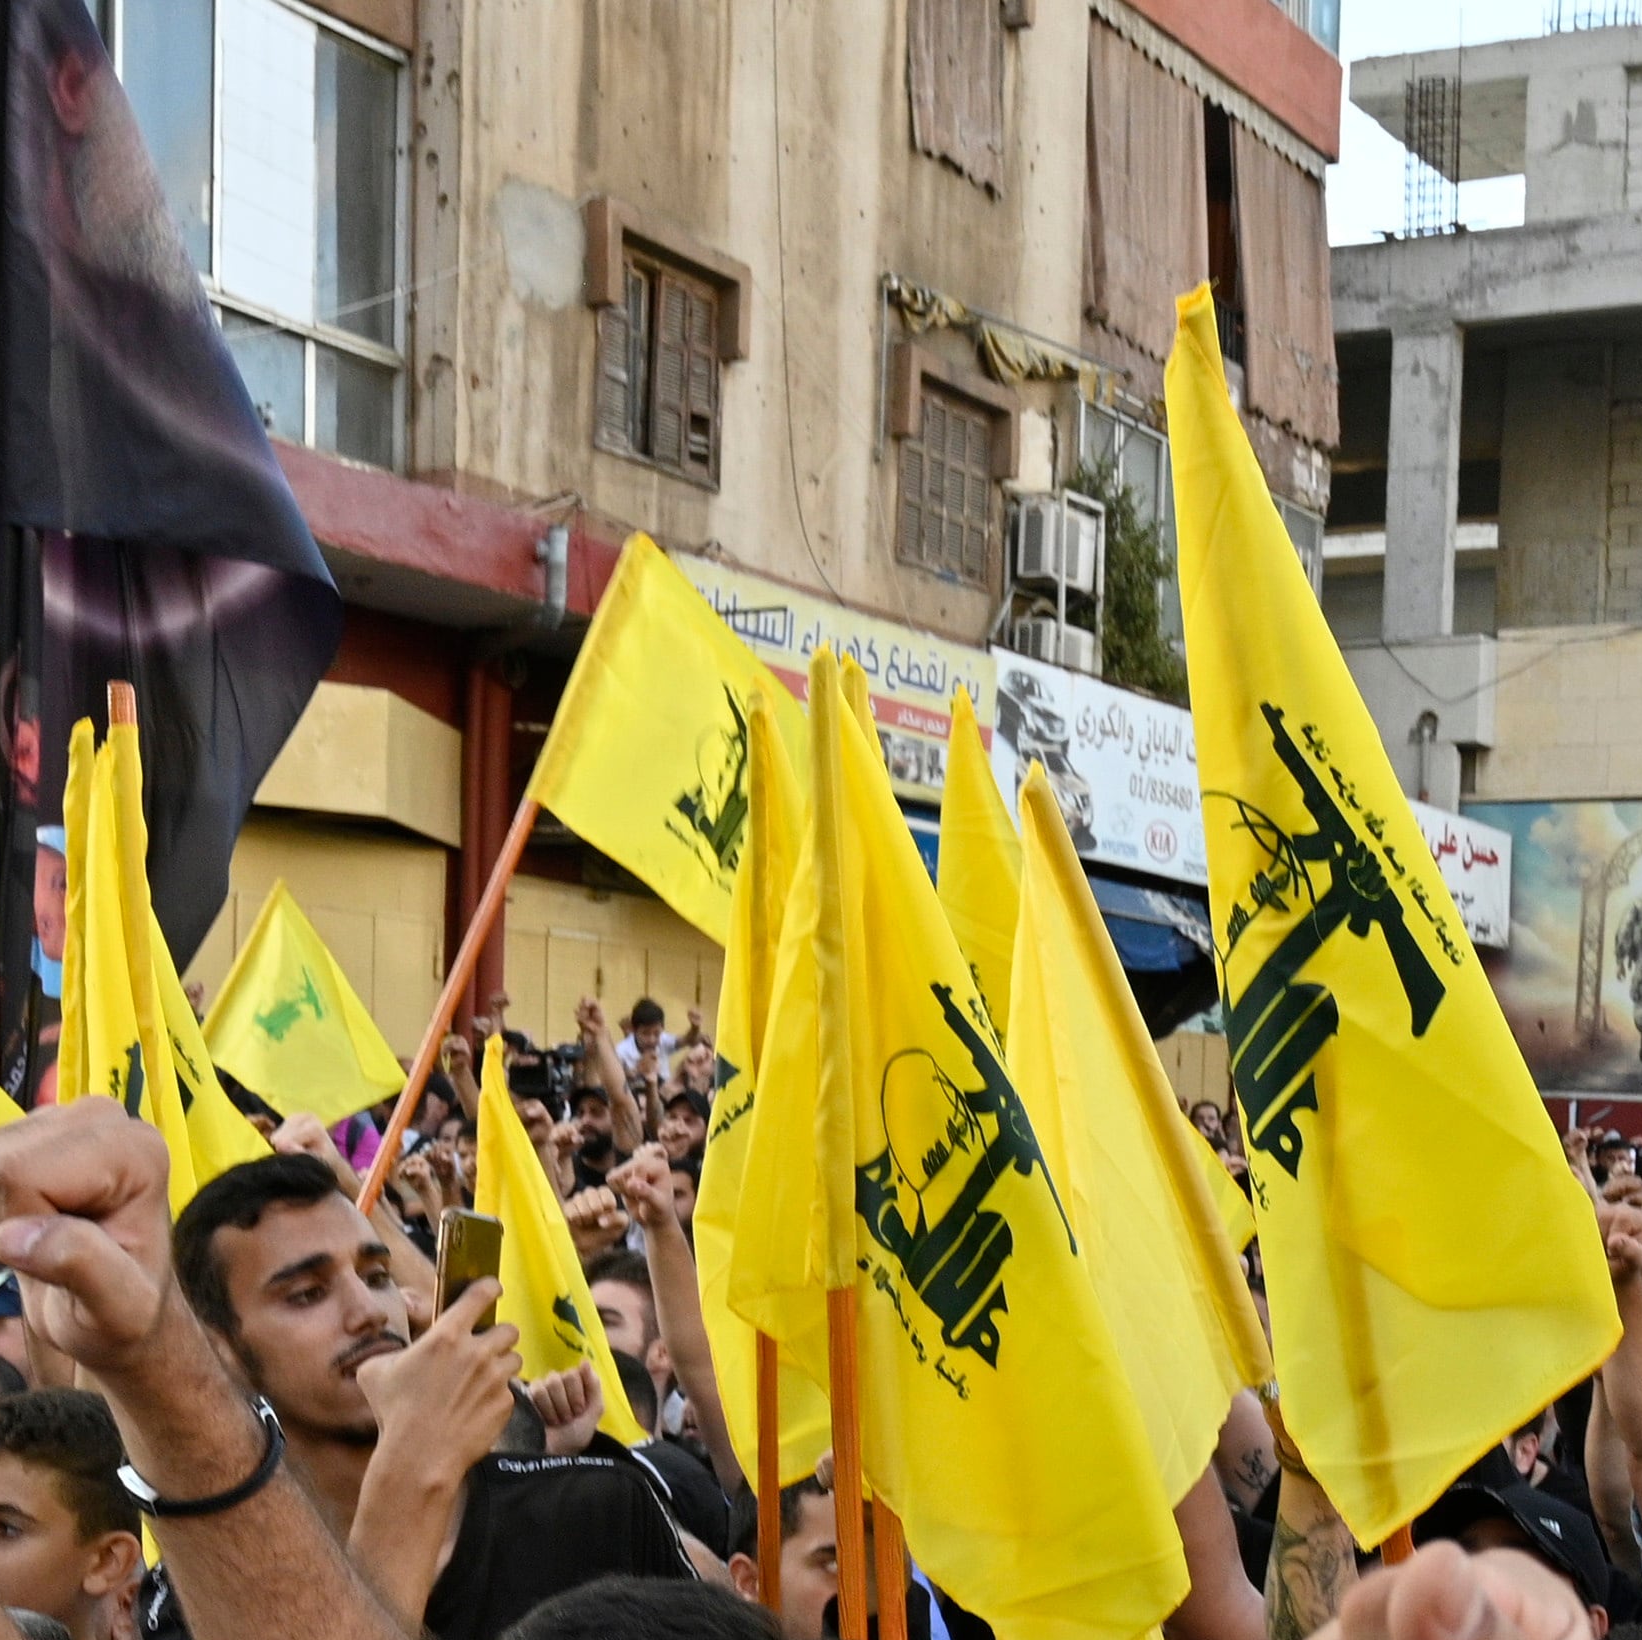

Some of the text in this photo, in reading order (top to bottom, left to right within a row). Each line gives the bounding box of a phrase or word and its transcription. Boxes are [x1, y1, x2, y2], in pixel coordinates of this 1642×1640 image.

[885, 645, 947, 694] لقطع
[1075, 703, 1134, 755] والكوري
[1138, 715, 1183, 772] الياباني
[1461, 833, 1499, 871] حسن
[709, 1091, 754, 1142] المقاوم
[497, 1457, 540, 1474] Calvin
[541, 1455, 573, 1470] Klein
